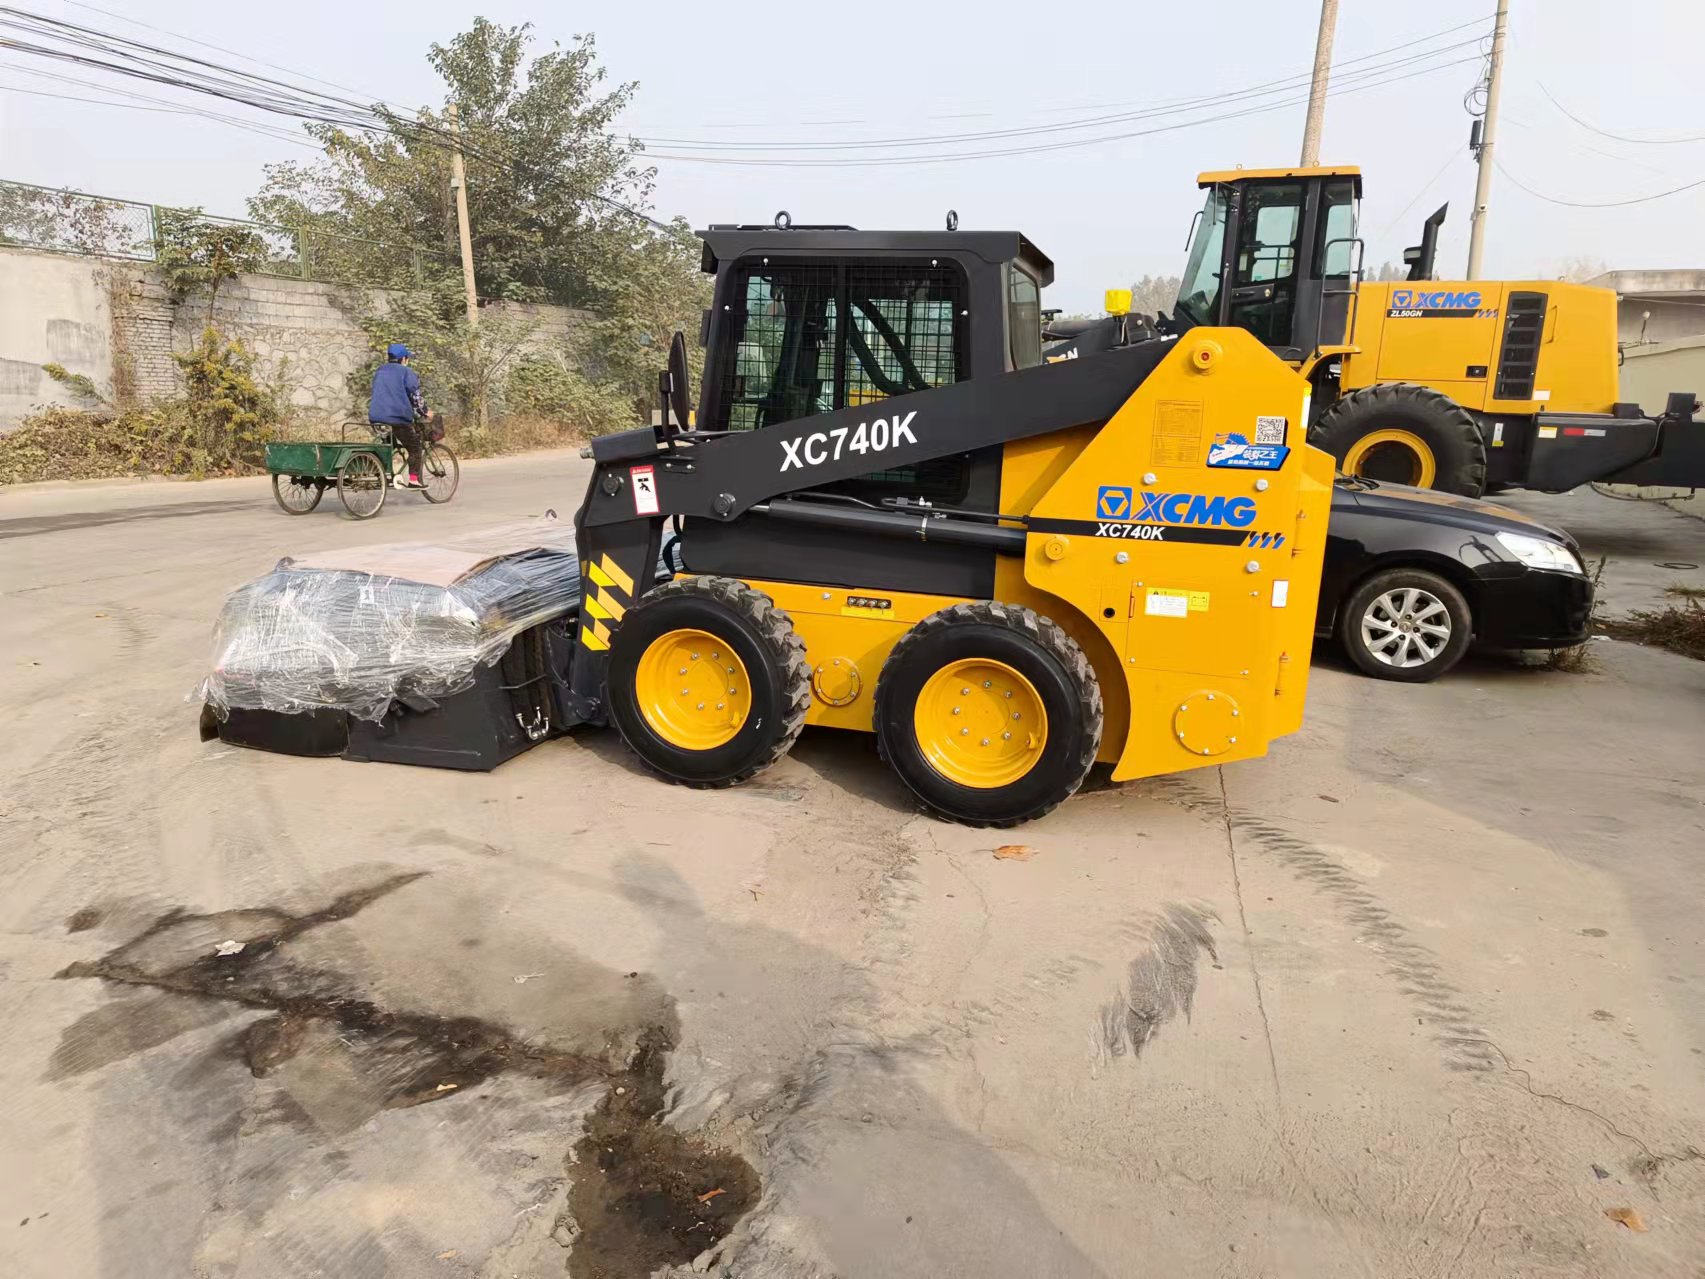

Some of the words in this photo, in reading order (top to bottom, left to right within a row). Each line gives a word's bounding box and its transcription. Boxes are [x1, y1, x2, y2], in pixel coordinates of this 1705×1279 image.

[1412, 292, 1481, 308] XCMG
[779, 410, 918, 472] XC740K
[1130, 491, 1257, 528] XCMG
[1095, 522, 1166, 541] XC740K
